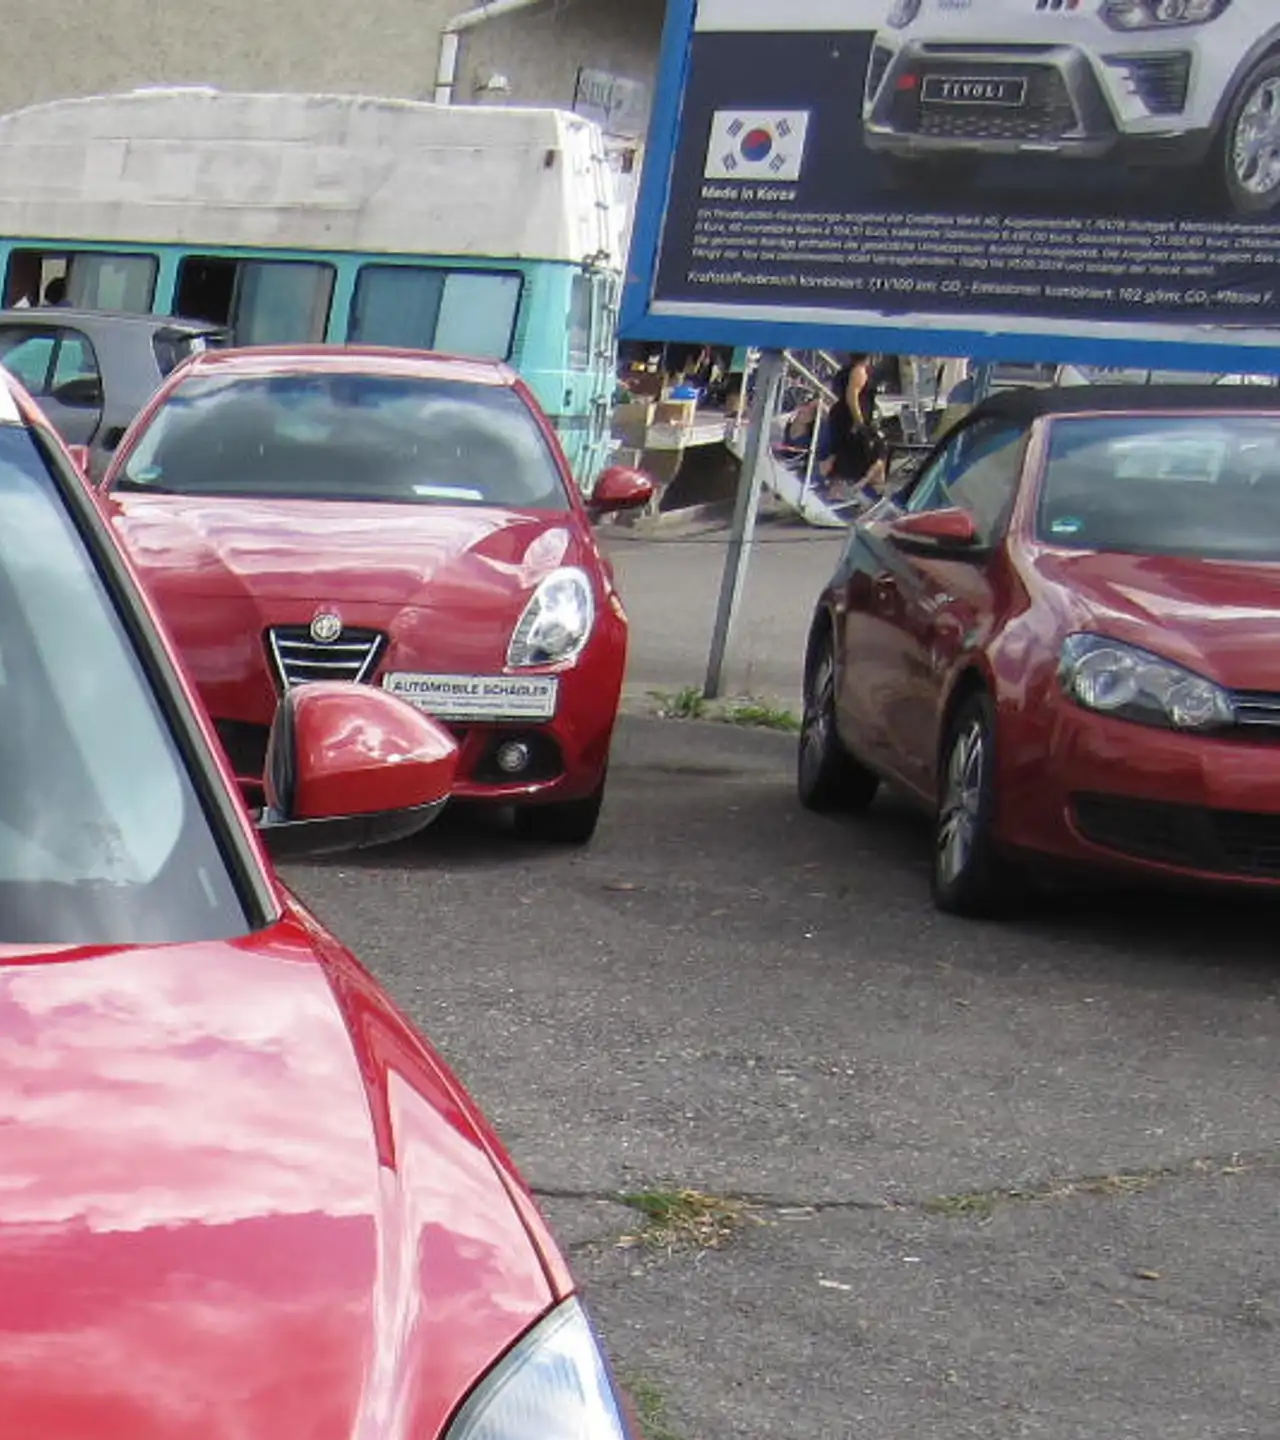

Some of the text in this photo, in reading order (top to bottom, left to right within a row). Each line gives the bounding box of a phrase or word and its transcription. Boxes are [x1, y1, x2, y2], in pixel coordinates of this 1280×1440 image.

[940, 83, 1005, 98] TIVOLI
[701, 186, 798, 201] Made in Korea
[393, 681, 479, 695] AUTOMOBILE
